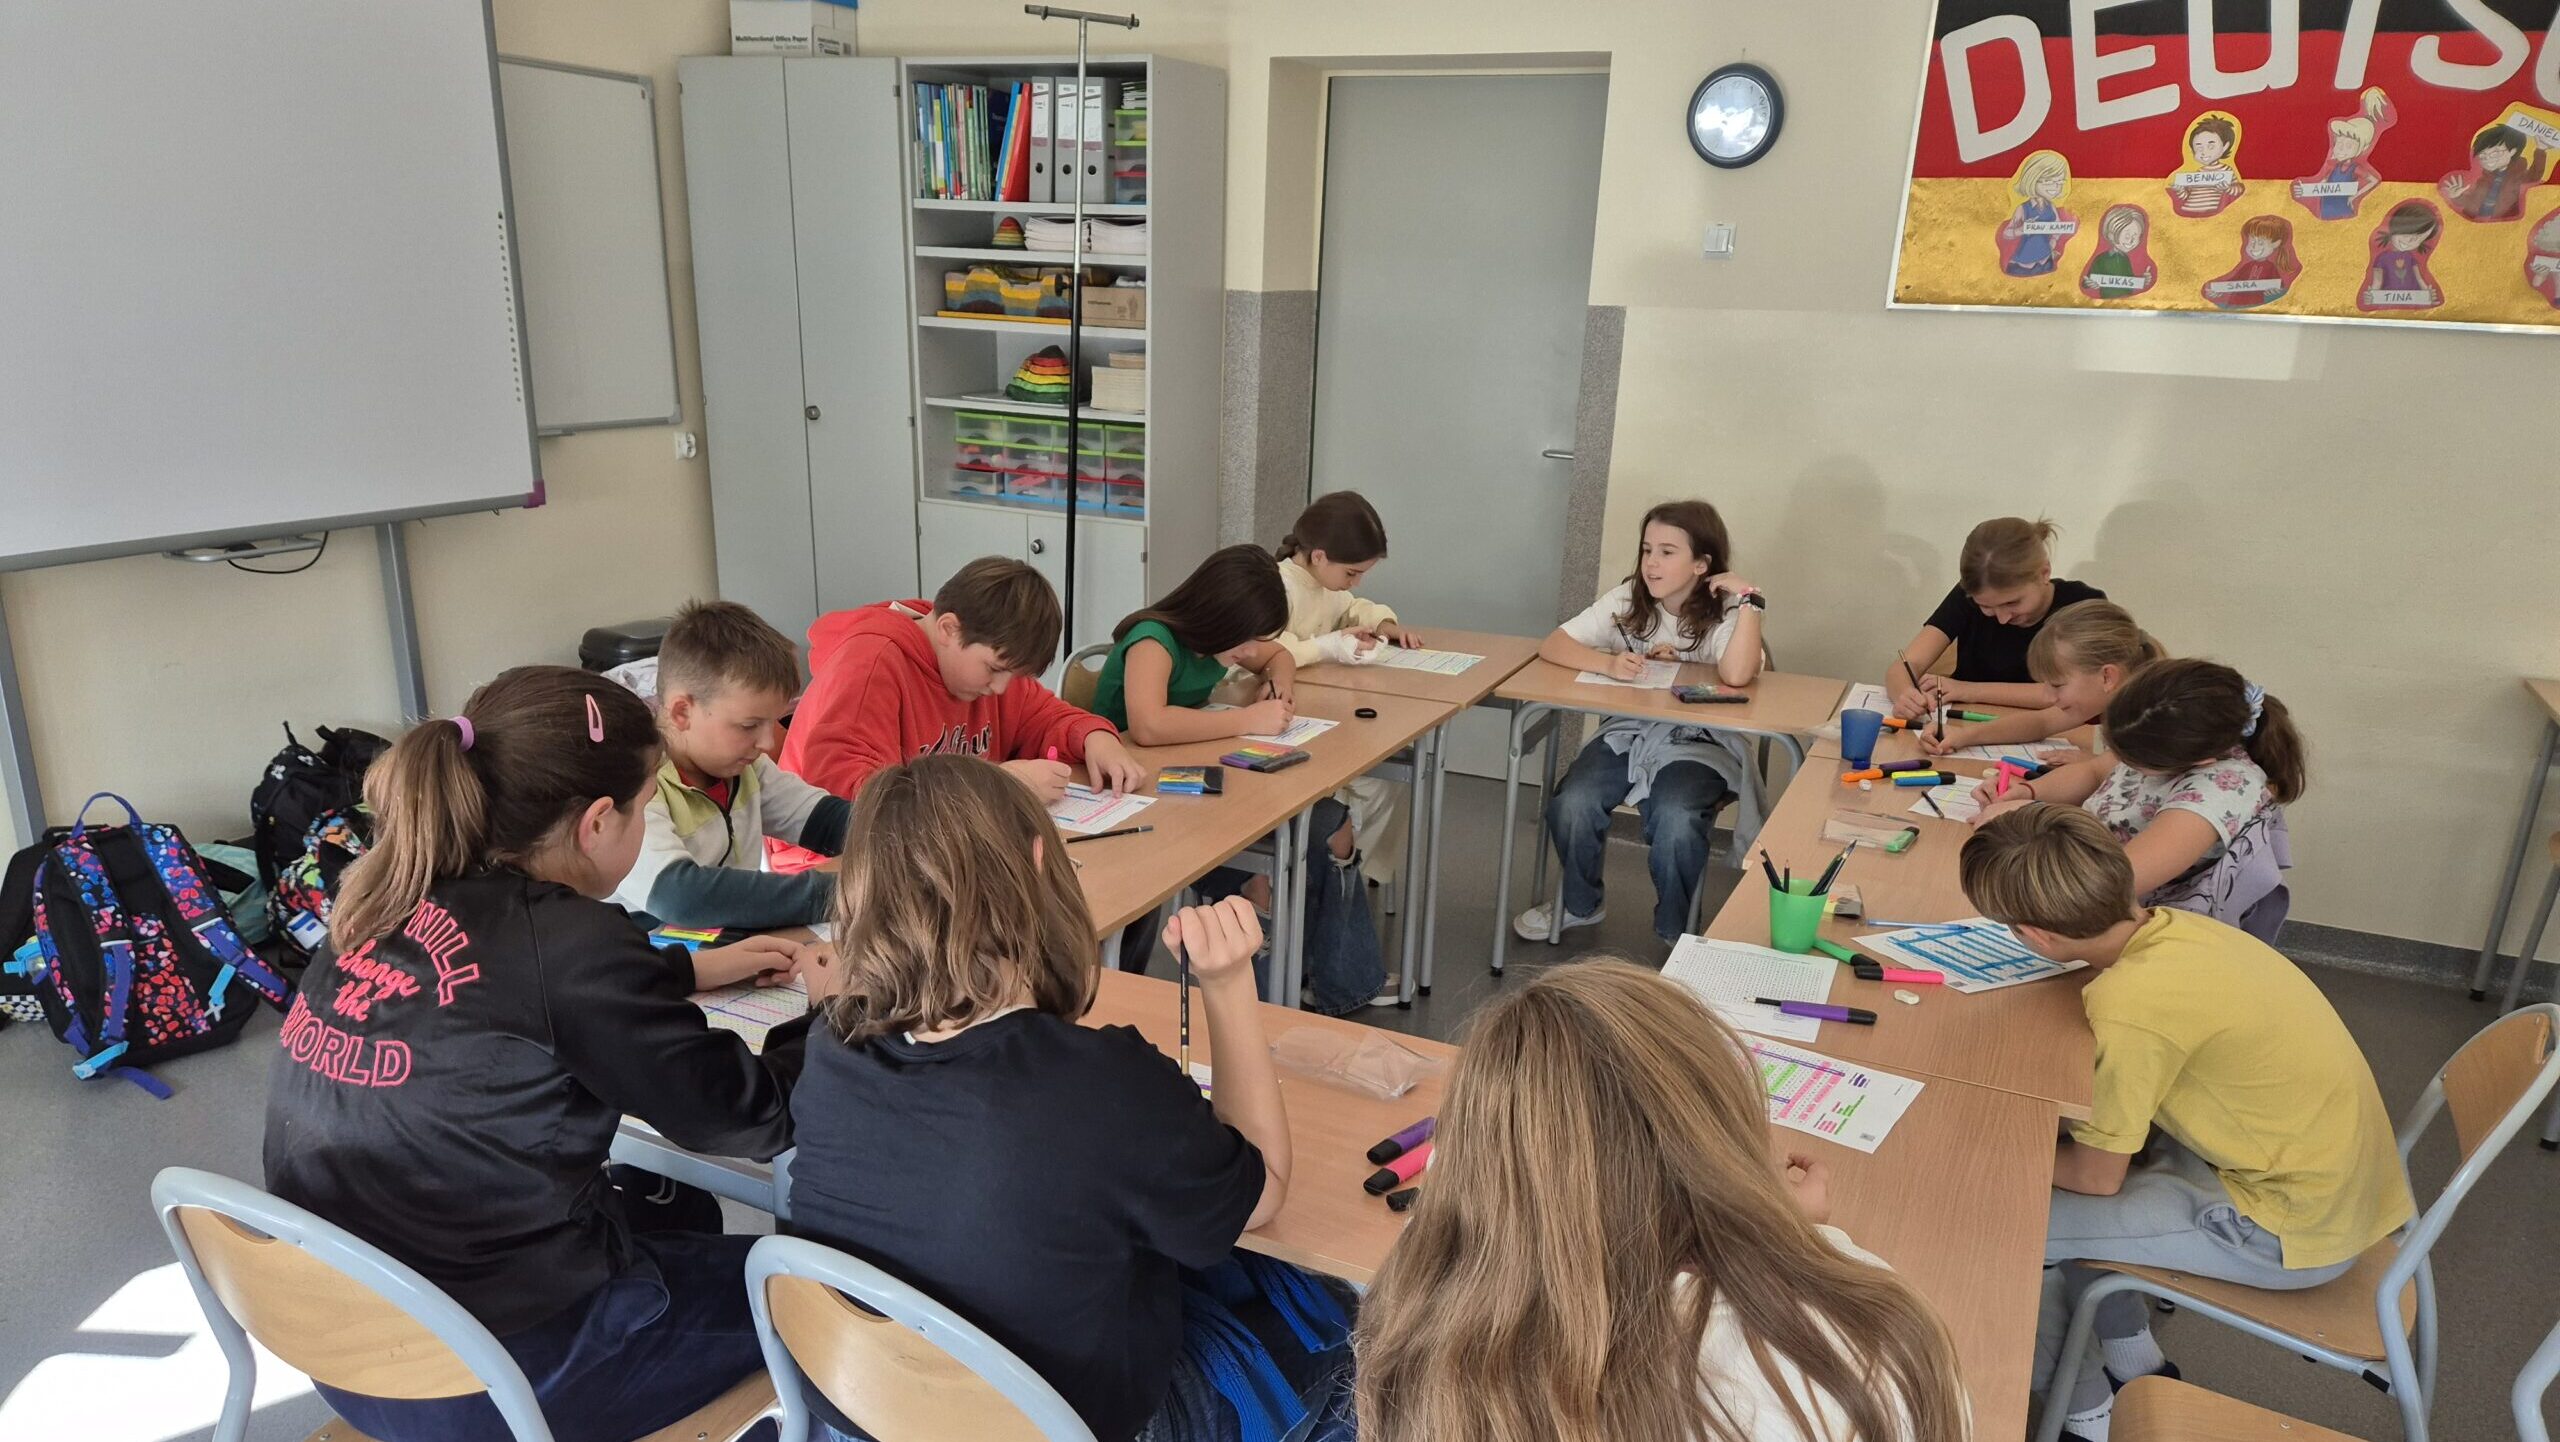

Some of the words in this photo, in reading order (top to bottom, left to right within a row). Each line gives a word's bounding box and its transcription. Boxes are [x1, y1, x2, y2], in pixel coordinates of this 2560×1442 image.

[1940, 0, 2560, 164] DEUS
[2519, 116, 2560, 141] DANIEL
[2186, 172, 2226, 183] BENNO
[2312, 183, 2342, 194] ANNA
[2026, 222, 2046, 232] FRAU
[2100, 275, 2135, 287] LUKAS
[2227, 281, 2258, 290] SARA
[2384, 292, 2413, 302] TINA
[404, 899, 480, 1007] WILL
[332, 980, 372, 1023] the
[280, 991, 413, 1088] WORLD
